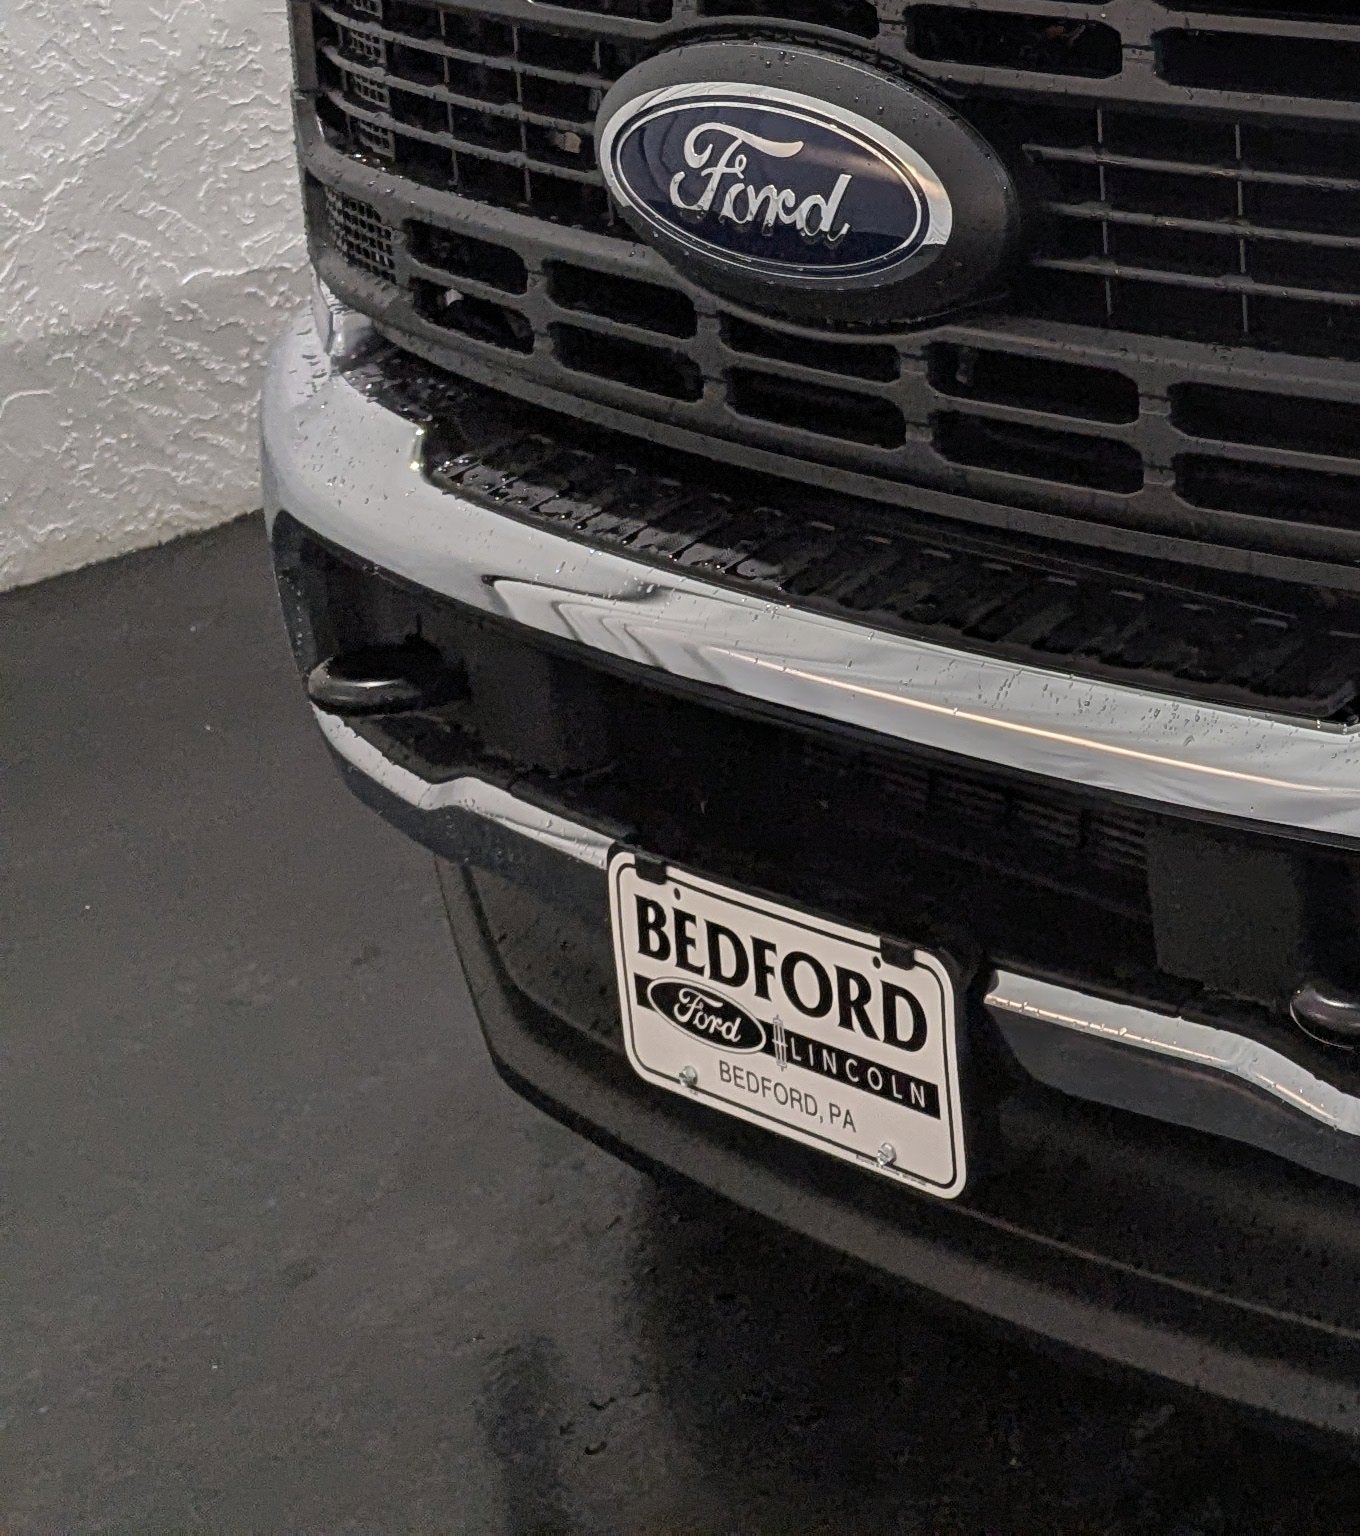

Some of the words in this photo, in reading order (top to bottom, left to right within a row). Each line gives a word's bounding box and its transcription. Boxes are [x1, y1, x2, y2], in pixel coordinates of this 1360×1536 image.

[669, 122, 852, 242] Ford
[634, 893, 928, 1052] BEDFORD
[673, 986, 742, 1044] Ford
[718, 1059, 825, 1124] BEDFORD,
[829, 1101, 857, 1133] PA
[790, 1035, 926, 1109] LINCOLN
